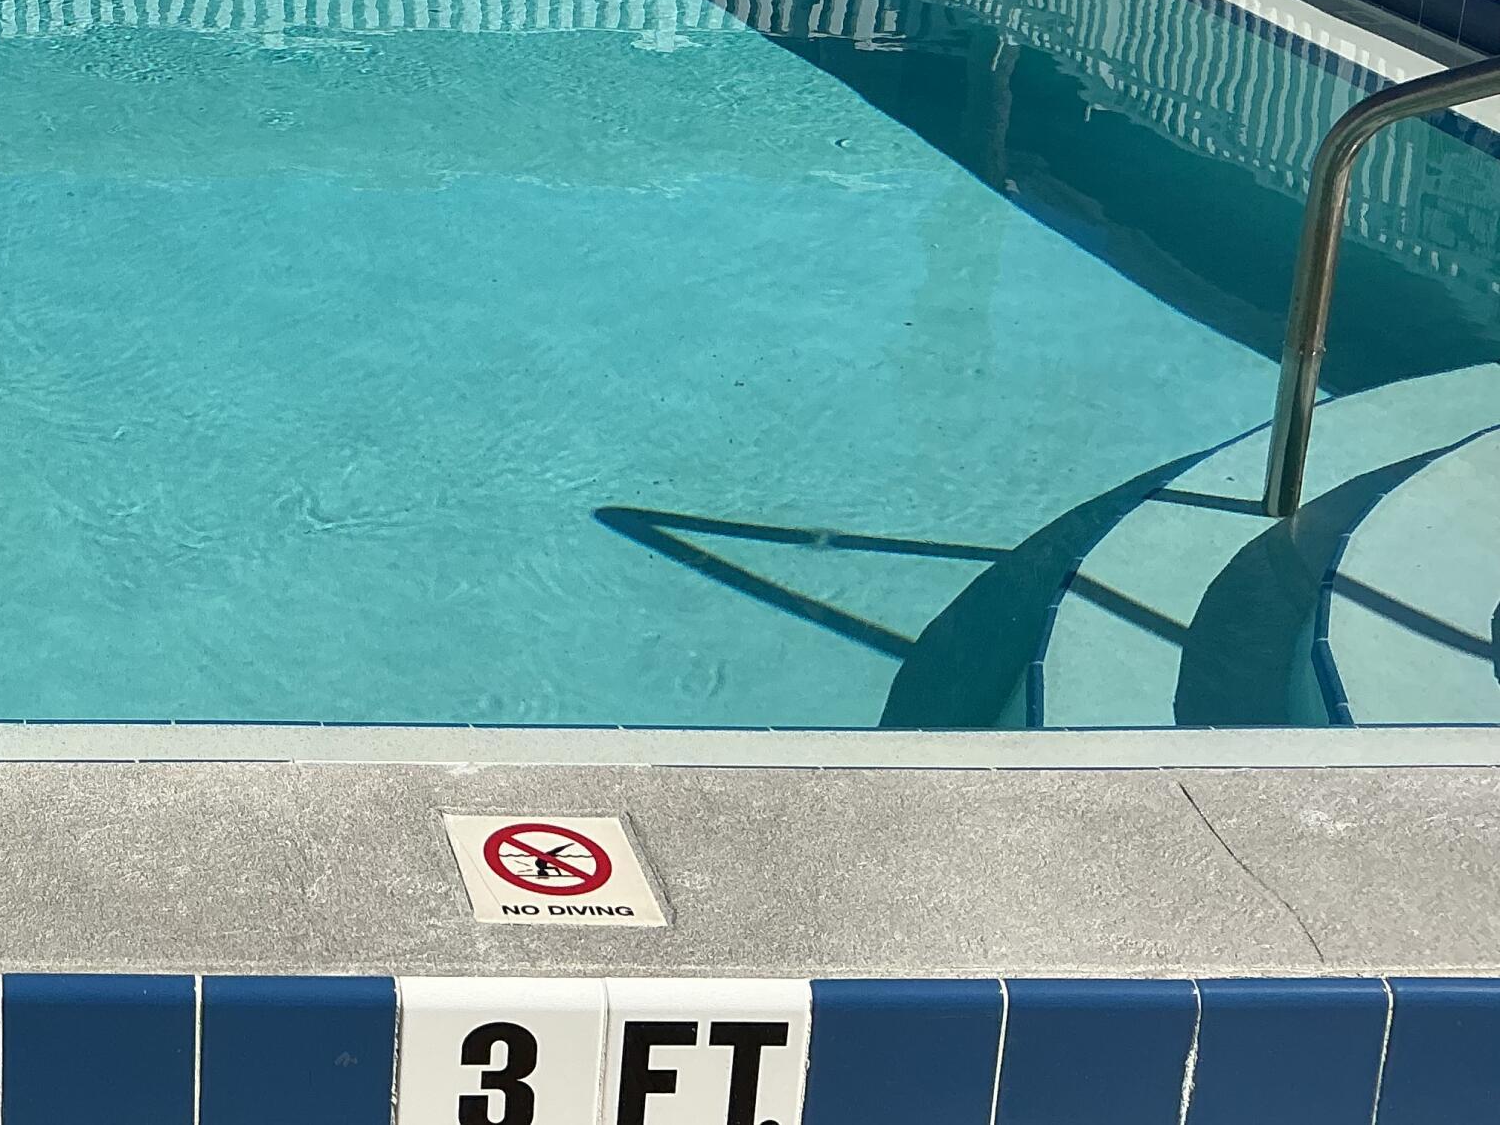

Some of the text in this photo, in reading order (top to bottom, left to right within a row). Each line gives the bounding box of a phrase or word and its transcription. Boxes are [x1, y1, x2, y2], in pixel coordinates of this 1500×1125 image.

[502, 905, 635, 917] NO DIVING
[459, 1020, 789, 1125] 3 FT
